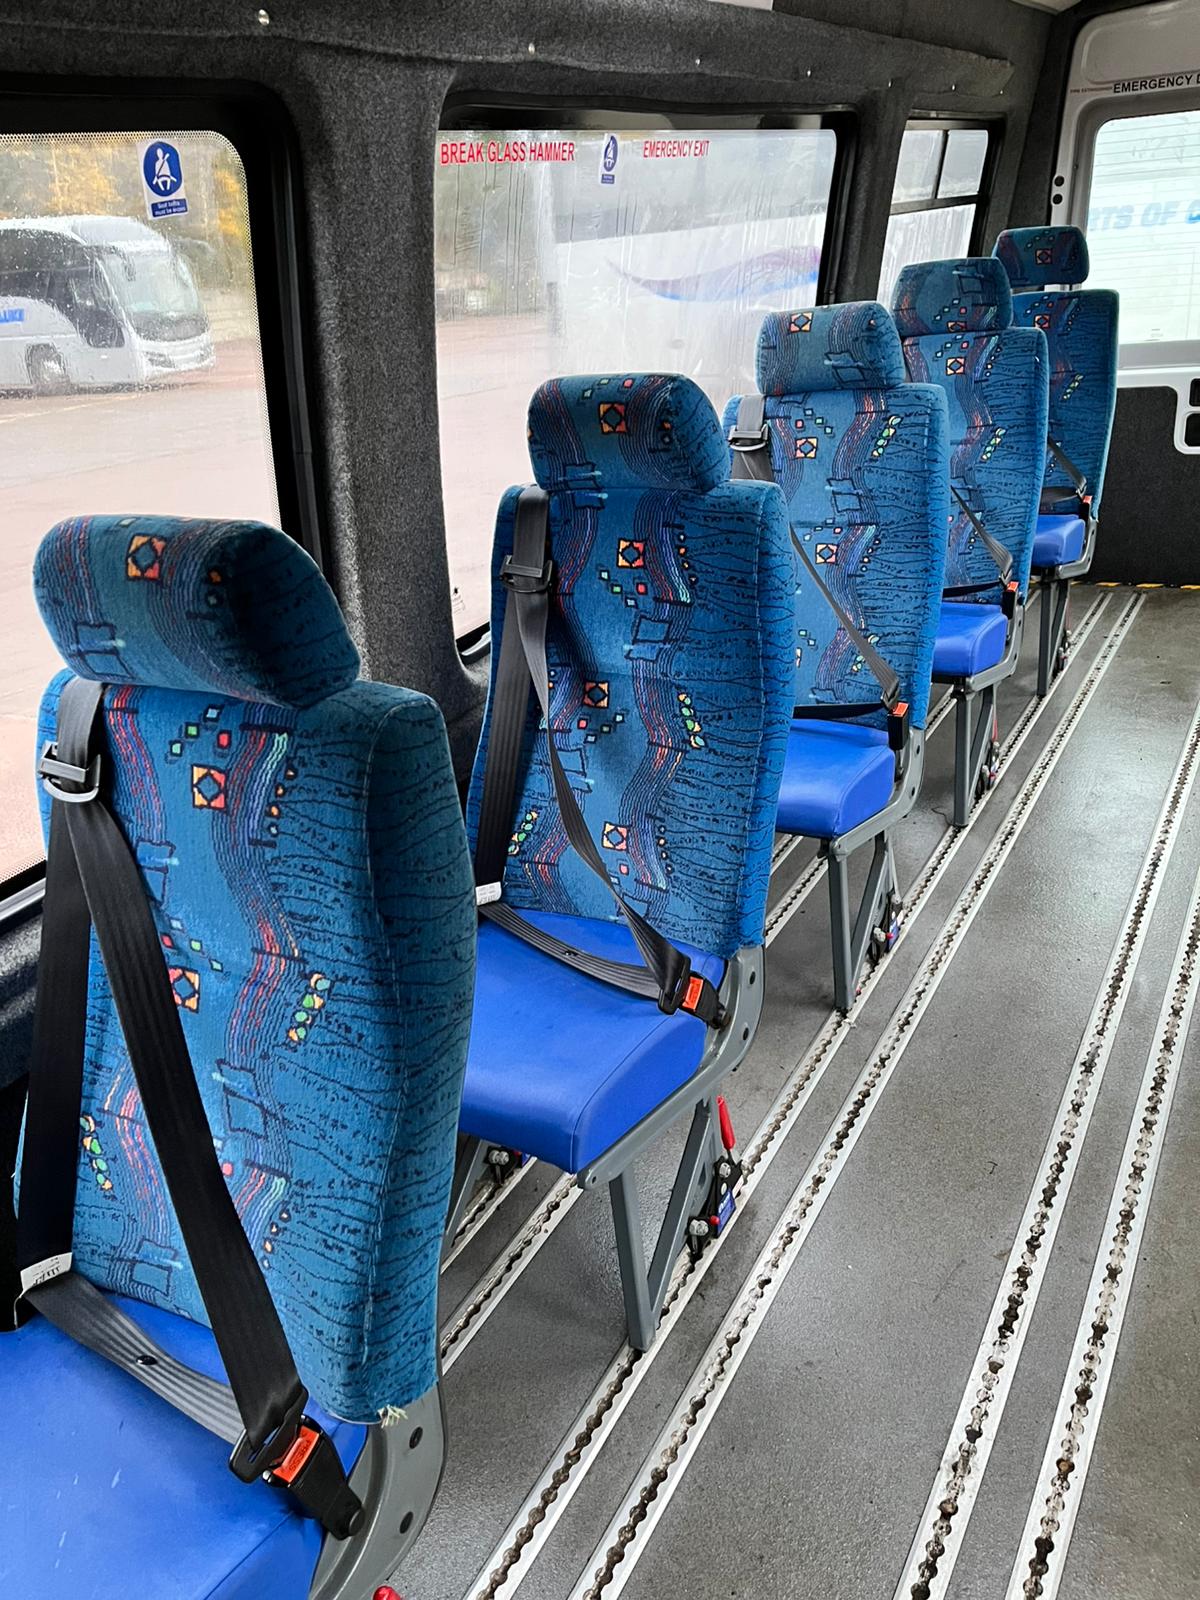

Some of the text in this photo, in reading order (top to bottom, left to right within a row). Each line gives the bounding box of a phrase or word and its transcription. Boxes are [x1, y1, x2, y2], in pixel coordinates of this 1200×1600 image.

[1113, 74, 1193, 94] EMERGENCY
[440, 141, 575, 164] BREAK GLASS HAMMER
[642, 140, 710, 159] EMERGENCY EXIT
